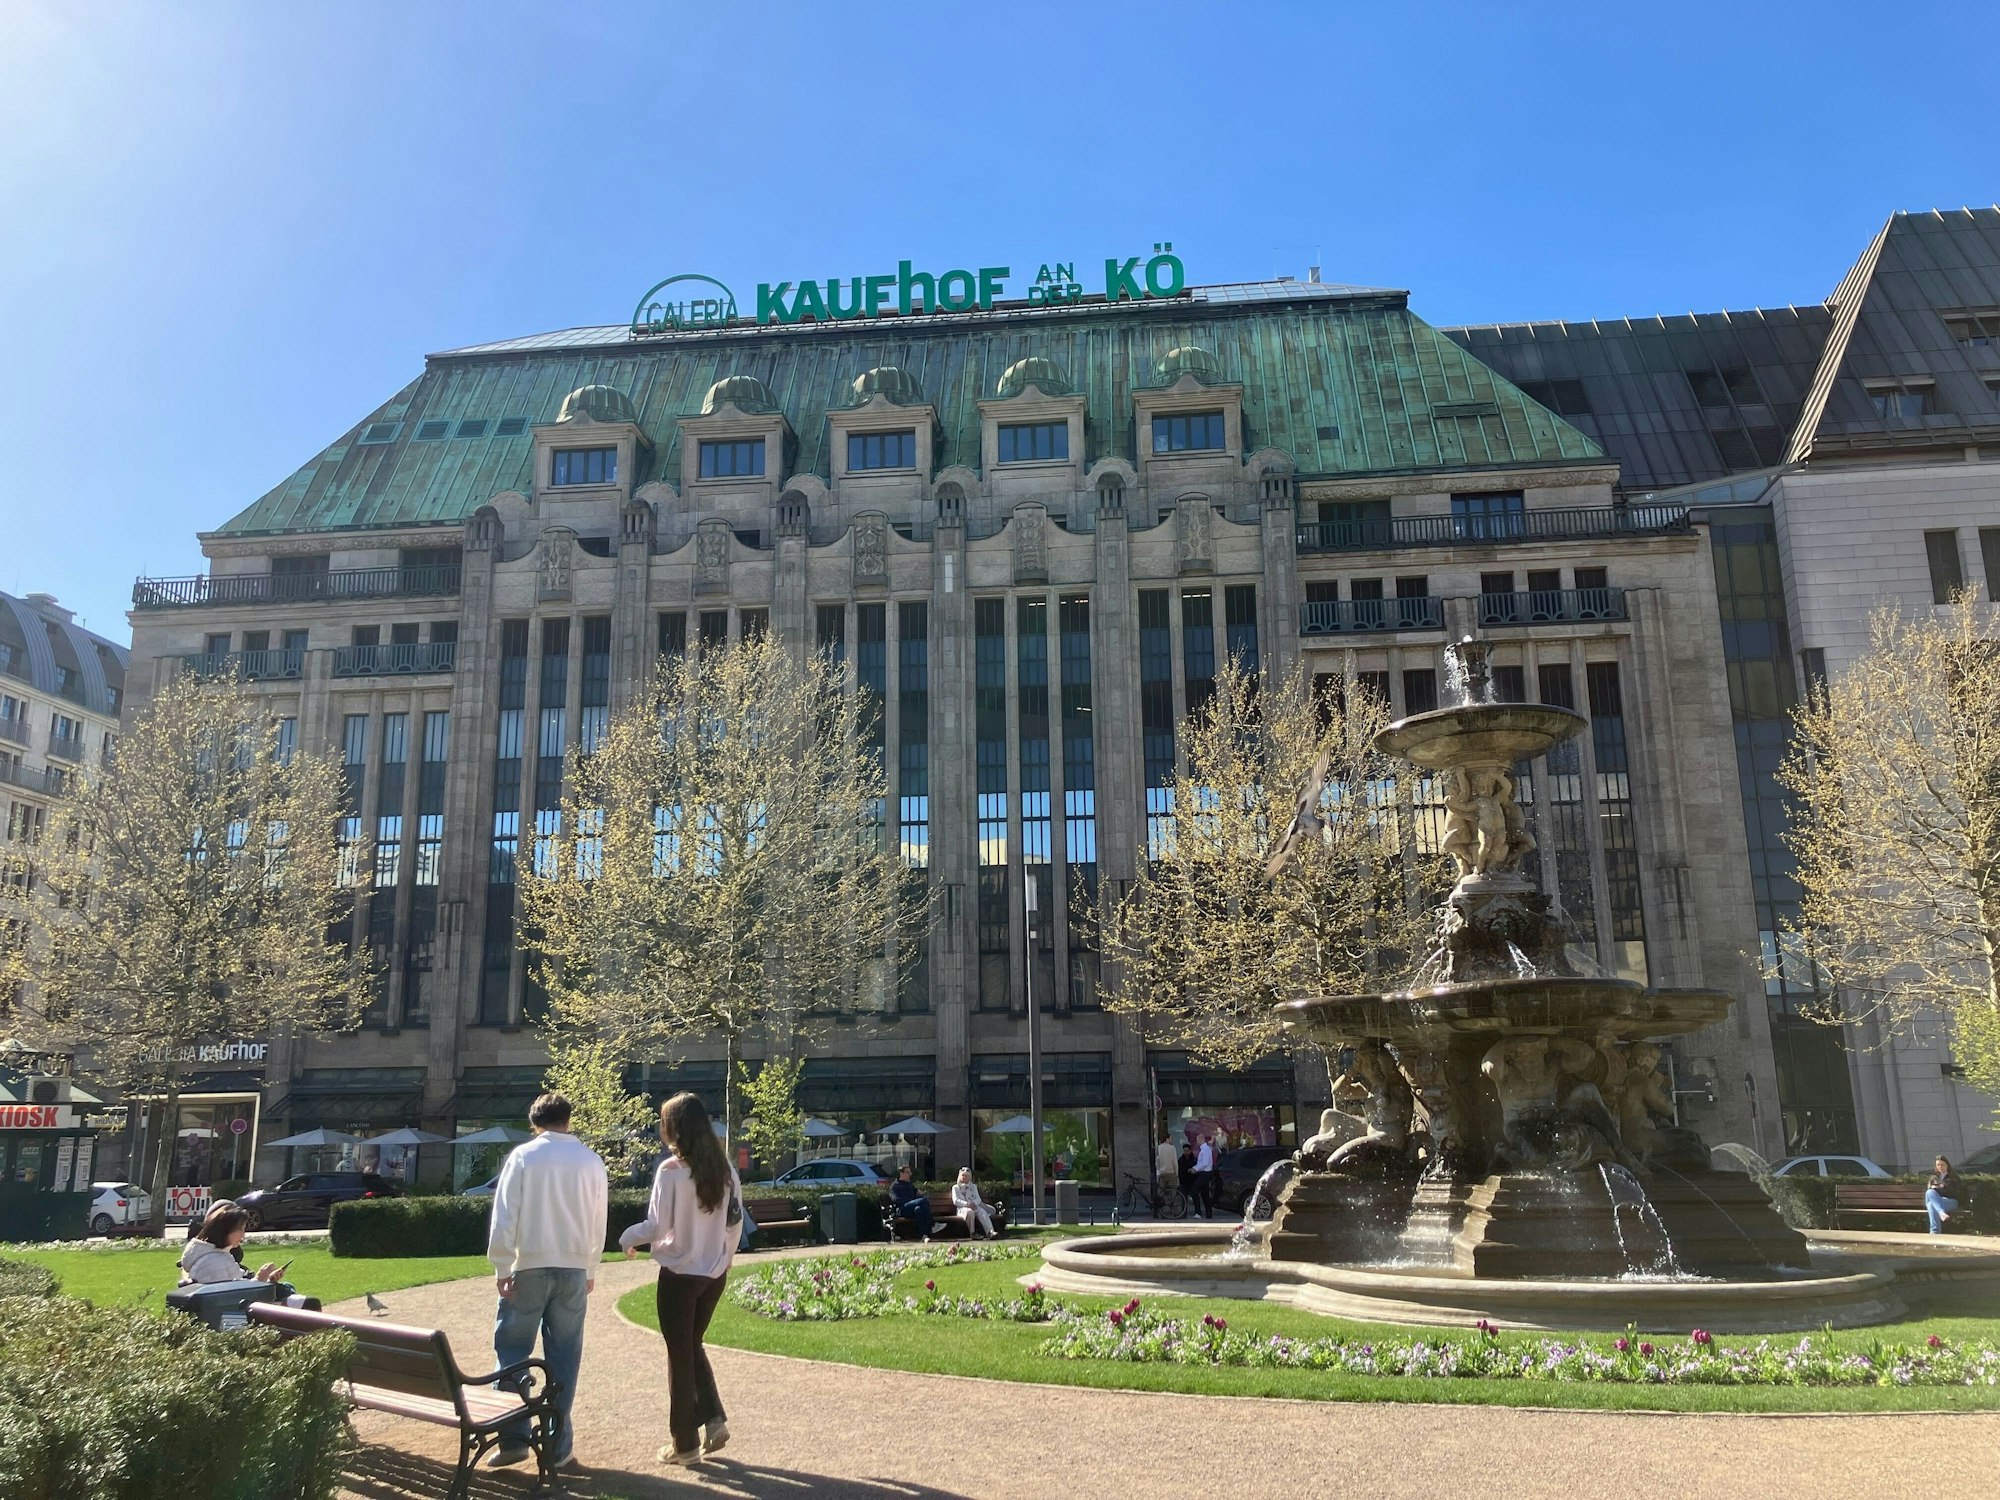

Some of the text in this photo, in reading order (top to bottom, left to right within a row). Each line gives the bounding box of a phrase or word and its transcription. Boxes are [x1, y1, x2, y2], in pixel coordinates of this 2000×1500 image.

[1035, 262, 1074, 284] AN
[1105, 242, 1185, 301] KÖ
[1028, 283, 1083, 306] DER
[647, 298, 740, 333] GALERIA
